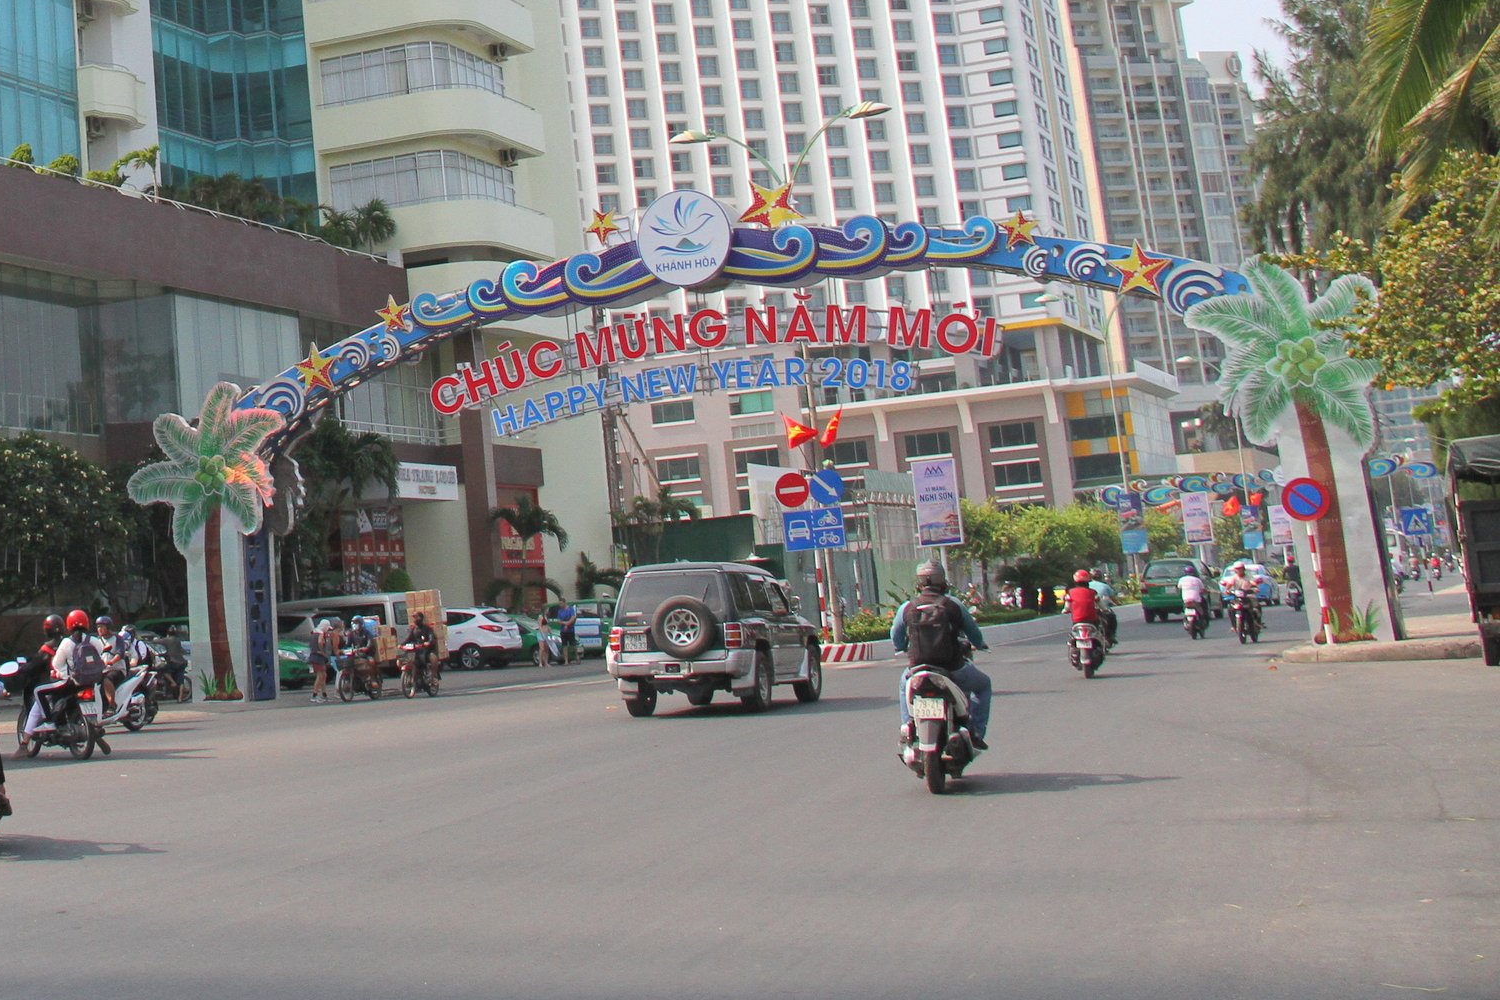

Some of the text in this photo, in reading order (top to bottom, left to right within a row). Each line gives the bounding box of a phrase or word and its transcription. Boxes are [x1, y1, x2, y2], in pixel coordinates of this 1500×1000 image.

[655, 255, 717, 273] KHÁNH HÒA
[430, 291, 997, 415] CHÚC MỪNG NĂM MỚI
[492, 356, 912, 436] HAPPY NEW YEAR 2018
